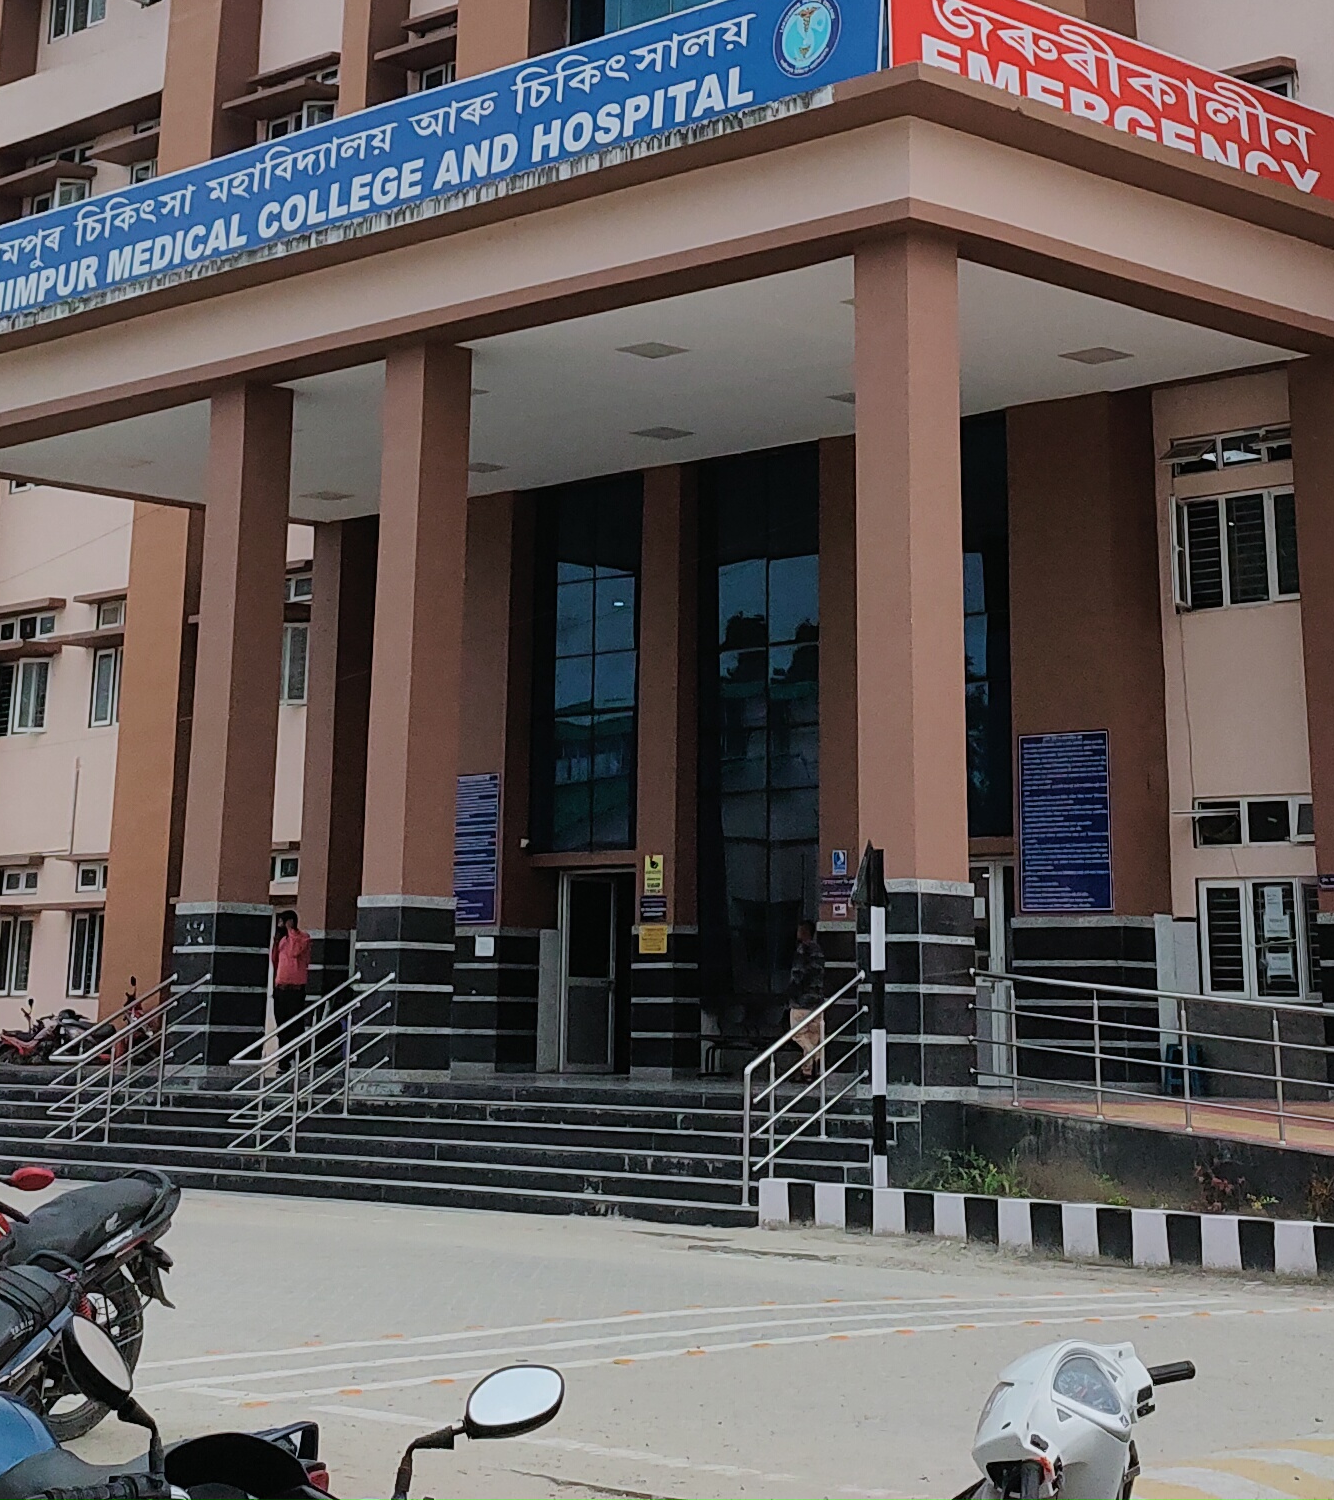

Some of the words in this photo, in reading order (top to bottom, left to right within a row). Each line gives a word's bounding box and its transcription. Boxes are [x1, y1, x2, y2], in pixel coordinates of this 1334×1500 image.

[106, 213, 248, 283] MEDICAL
[257, 158, 424, 239] COLLEGE
[432, 133, 519, 190] AND
[531, 66, 754, 163] HOSPITAL
[408, 91, 498, 137] আৰু
